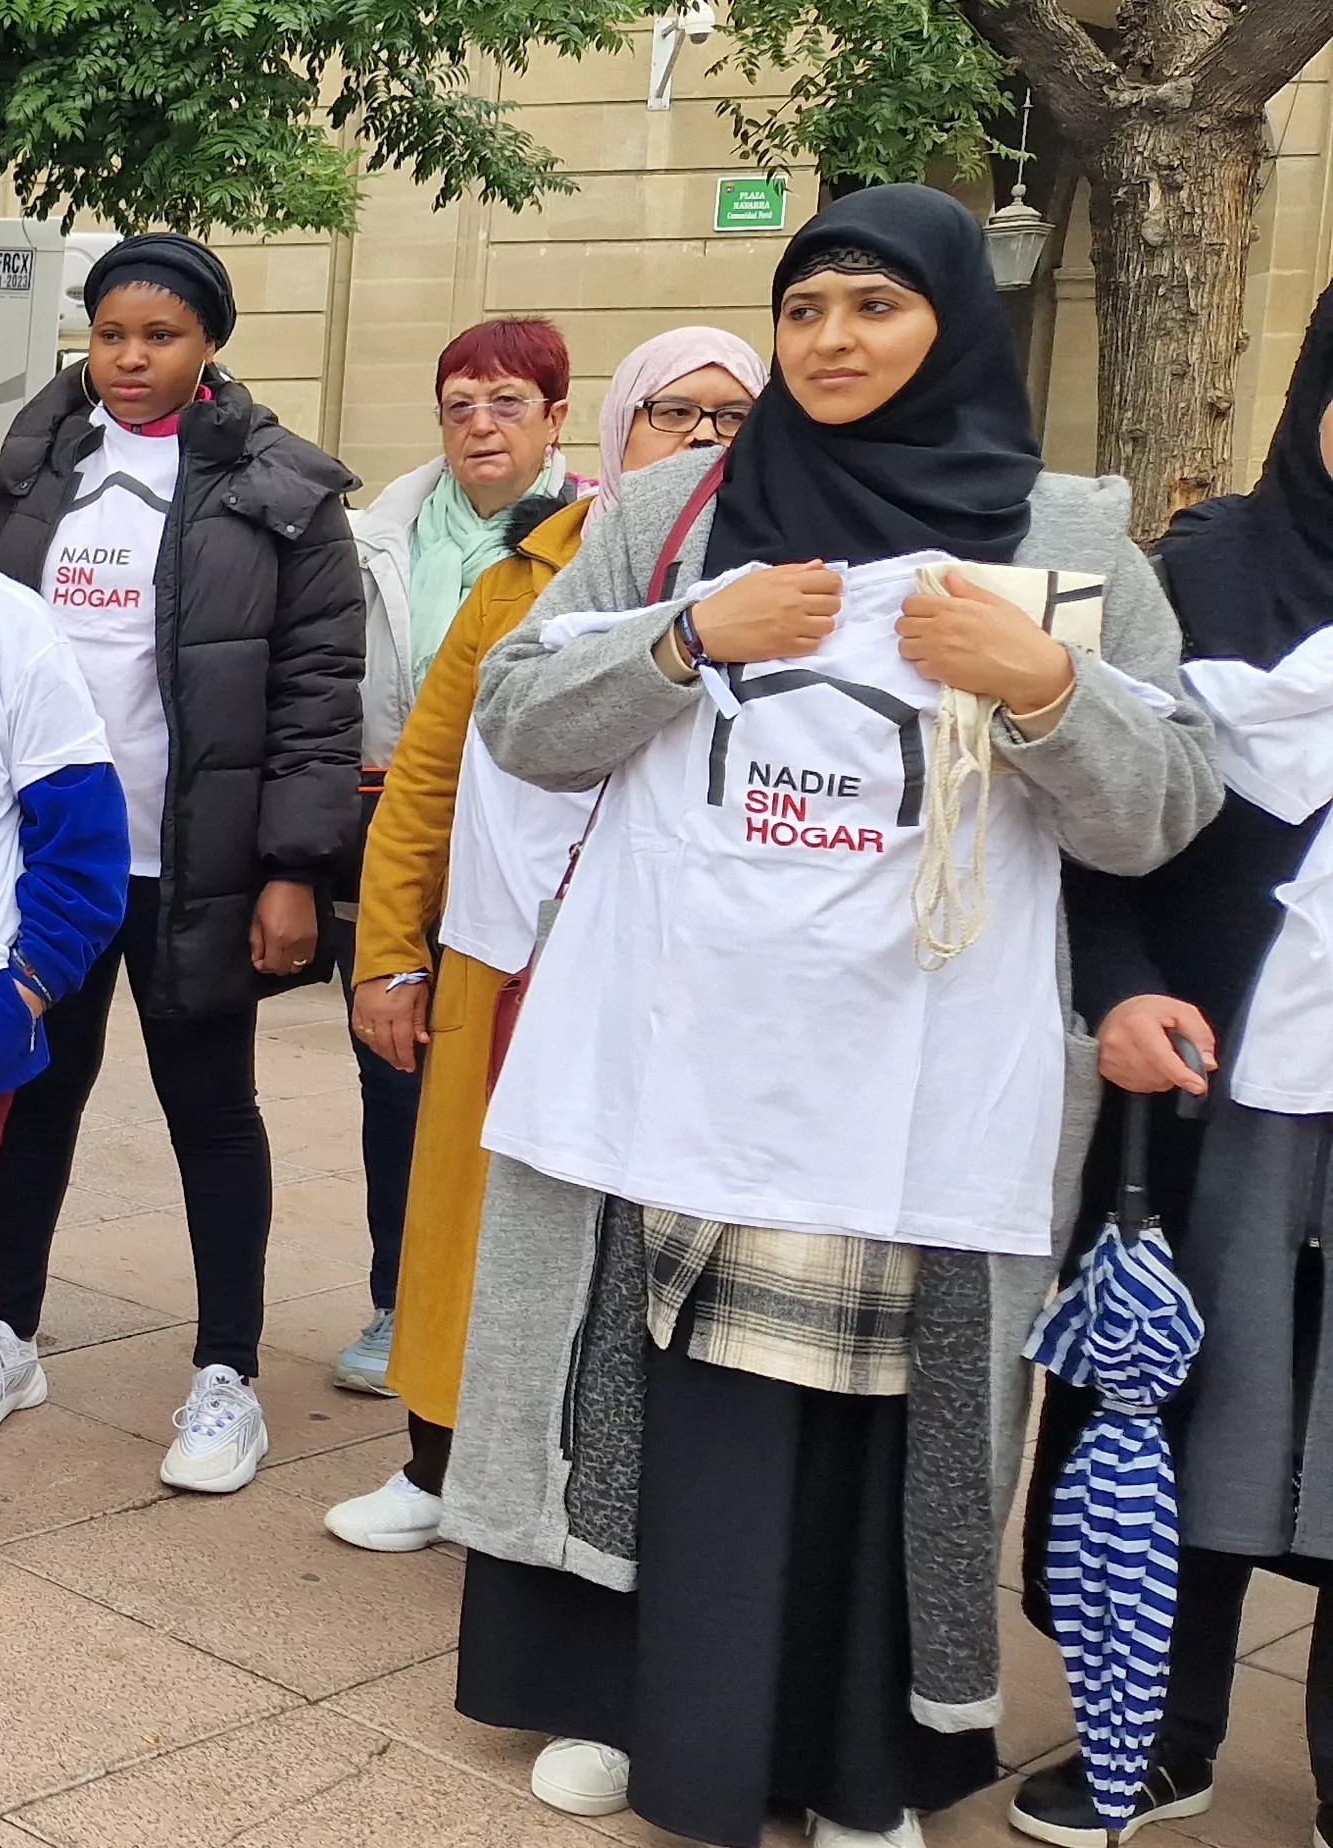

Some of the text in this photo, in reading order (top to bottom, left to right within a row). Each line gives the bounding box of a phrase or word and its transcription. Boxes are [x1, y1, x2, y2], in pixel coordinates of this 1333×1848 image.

[733, 201, 770, 209] NAVARRA
[739, 191, 765, 200] PLAZA
[60, 547, 132, 565] NADIE
[56, 566, 94, 585] SIN
[53, 587, 141, 608] HOGAR
[748, 761, 862, 797] NADIE
[745, 789, 807, 822] SIN
[746, 816, 884, 853] HOGAR
